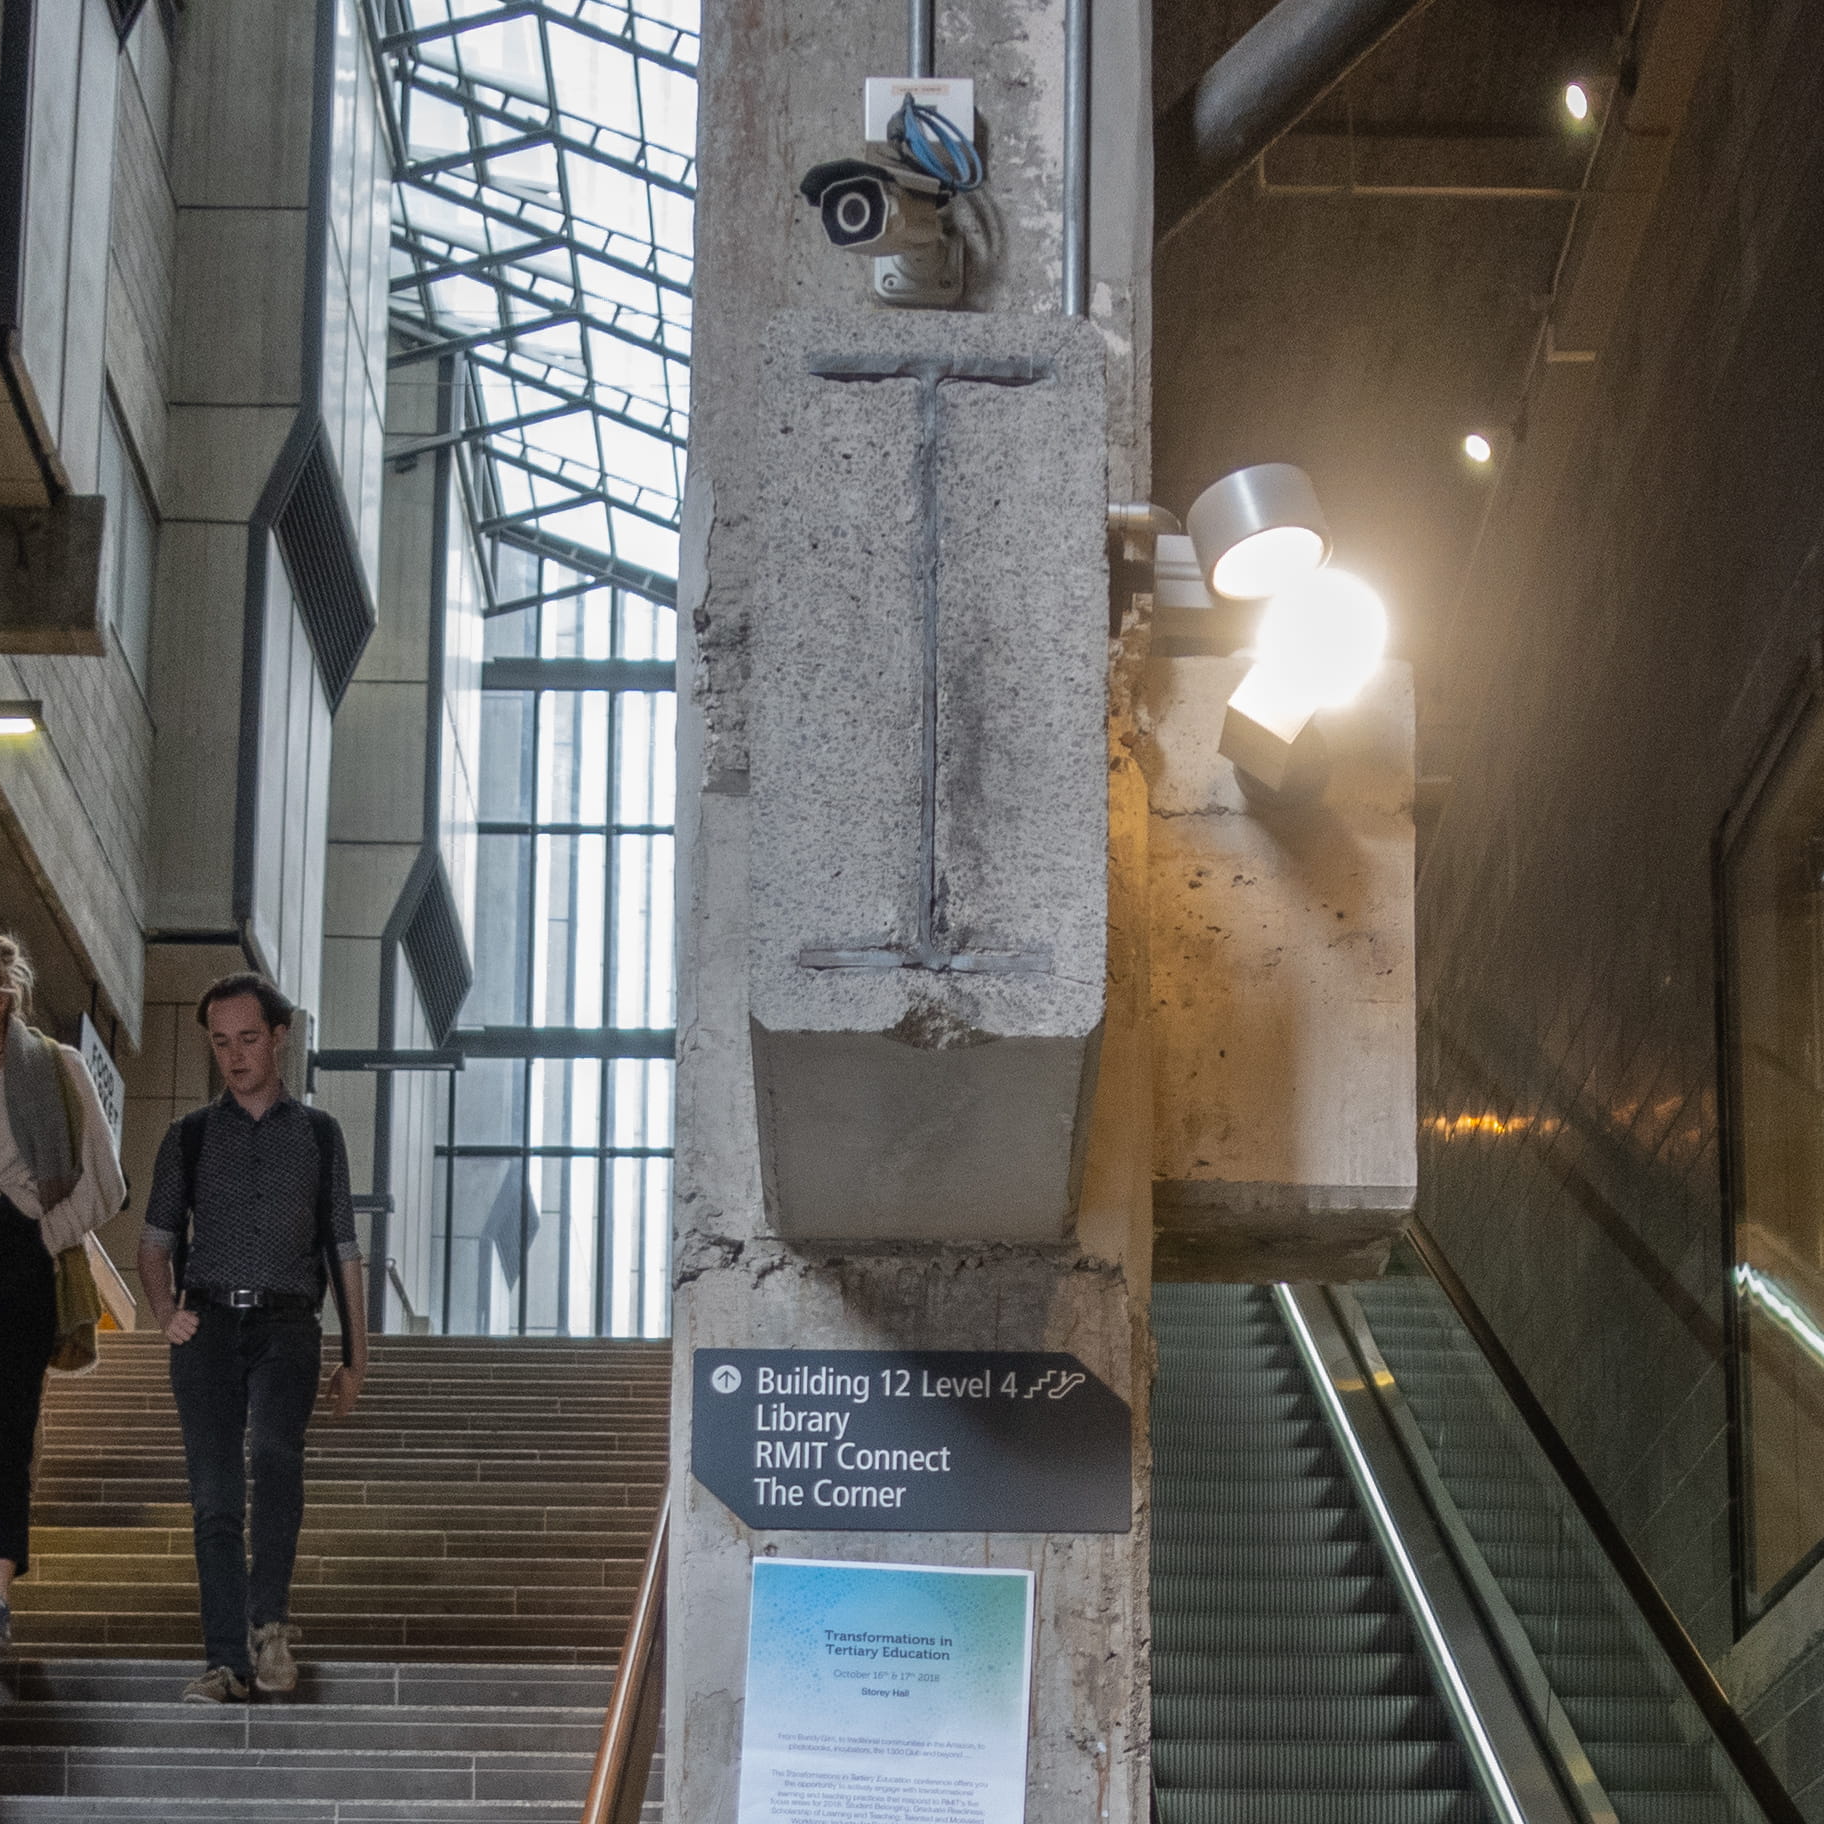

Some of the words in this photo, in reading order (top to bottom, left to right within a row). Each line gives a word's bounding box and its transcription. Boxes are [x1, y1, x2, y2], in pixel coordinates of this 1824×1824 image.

[758, 1366, 870, 1404] Building
[880, 1369, 911, 1397] 12
[922, 1369, 991, 1399] Level
[1000, 1371, 1018, 1399] 4
[757, 1402, 850, 1440] Library
[756, 1441, 828, 1469] RMIT
[837, 1442, 951, 1472] Connect
[754, 1476, 804, 1506] The
[813, 1479, 907, 1507] Corner
[824, 1629, 936, 1646] Transformations
[940, 1635, 953, 1647] in
[825, 1643, 879, 1660] Tertiary
[882, 1646, 950, 1661] Education
[833, 1668, 870, 1680] October
[861, 1686, 890, 1698] Storey
[892, 1687, 910, 1698] Hall
